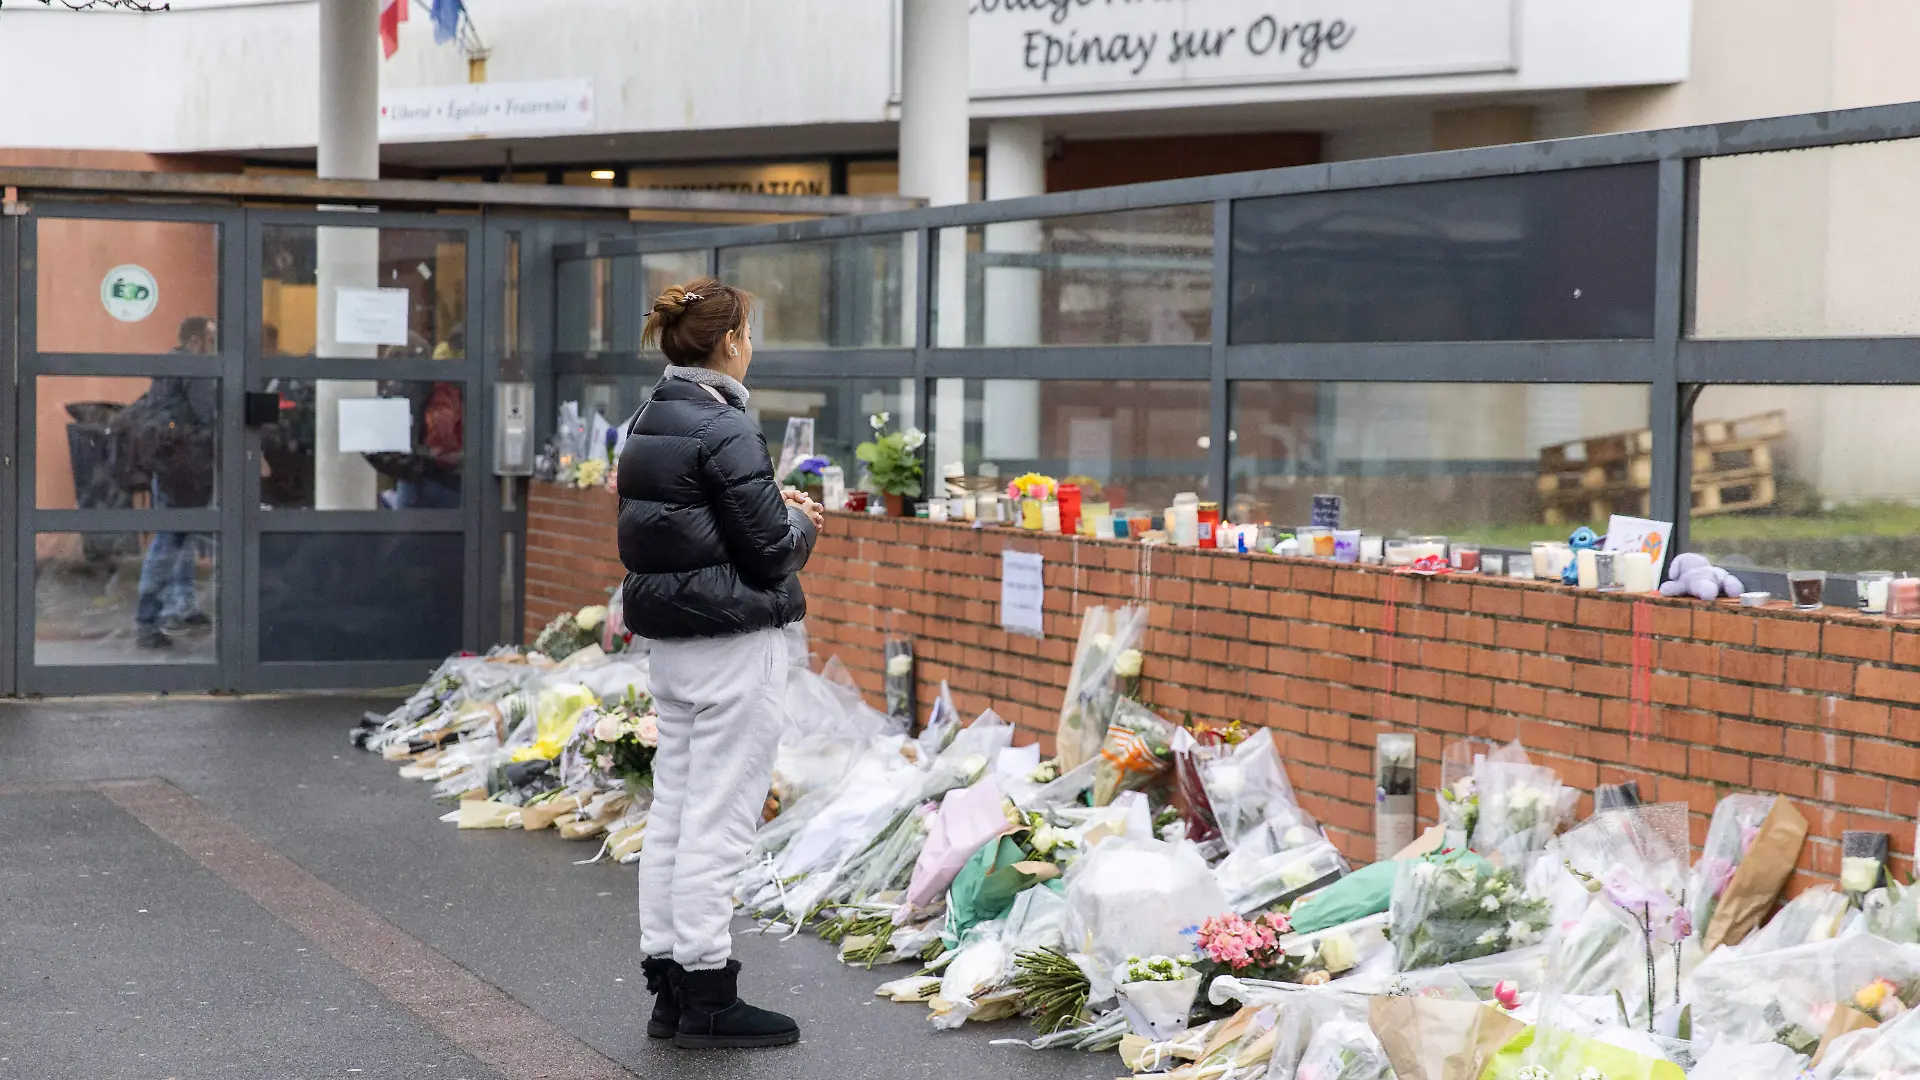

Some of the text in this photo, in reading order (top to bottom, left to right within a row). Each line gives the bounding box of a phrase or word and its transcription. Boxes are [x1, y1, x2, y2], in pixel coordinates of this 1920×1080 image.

[1022, 13, 1357, 81] Epinay sur Orge
